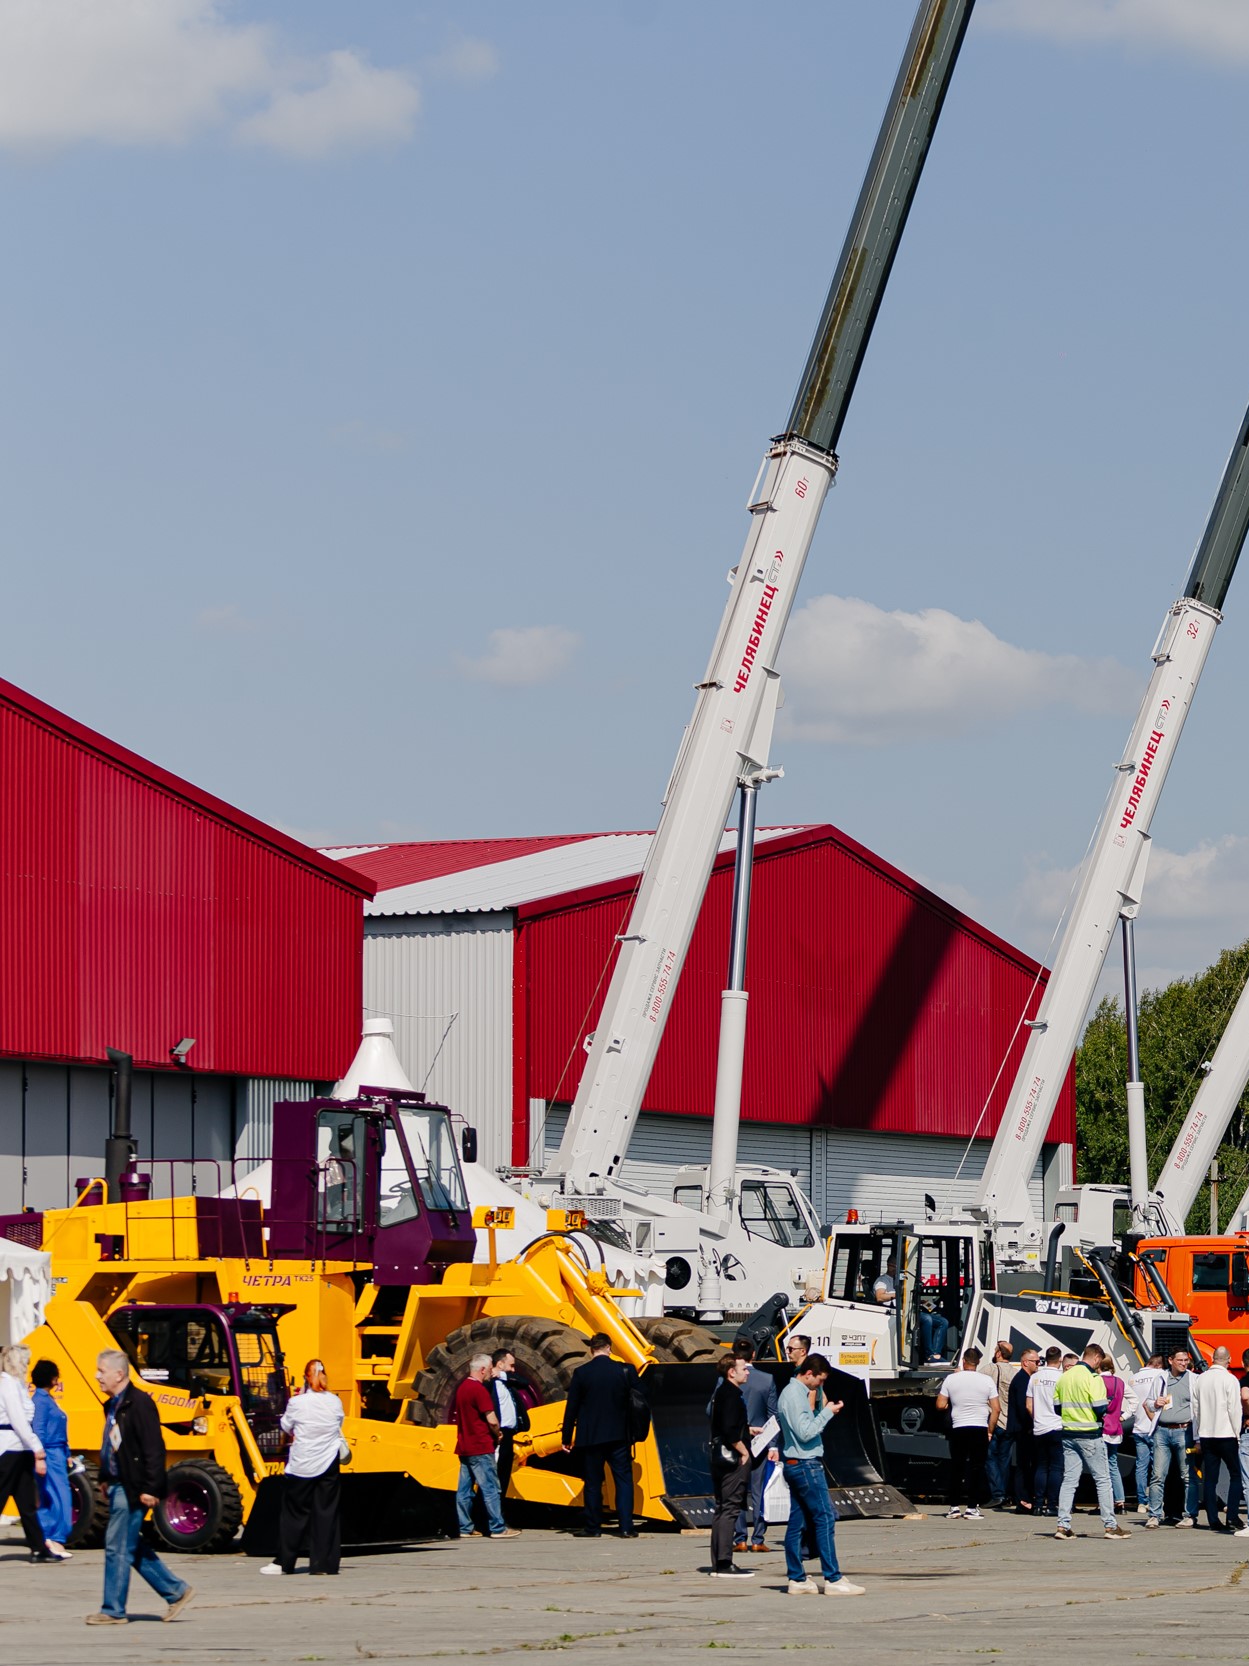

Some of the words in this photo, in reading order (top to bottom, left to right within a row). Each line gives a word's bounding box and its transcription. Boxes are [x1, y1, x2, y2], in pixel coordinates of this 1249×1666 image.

[733, 583, 779, 694] ЧЕЛЯБИНЕЦ
[1120, 730, 1165, 829] ЧЕЛЯБИНЕЦ
[649, 951, 676, 1023] 8-800-555-74-74
[1015, 1076, 1041, 1141] 8-800-555-74-74
[1174, 1111, 1203, 1169] 8-800-555-74-74
[243, 1275, 291, 1287] ЧЕТРА
[1051, 1302, 1089, 1317] ЧЗПТ
